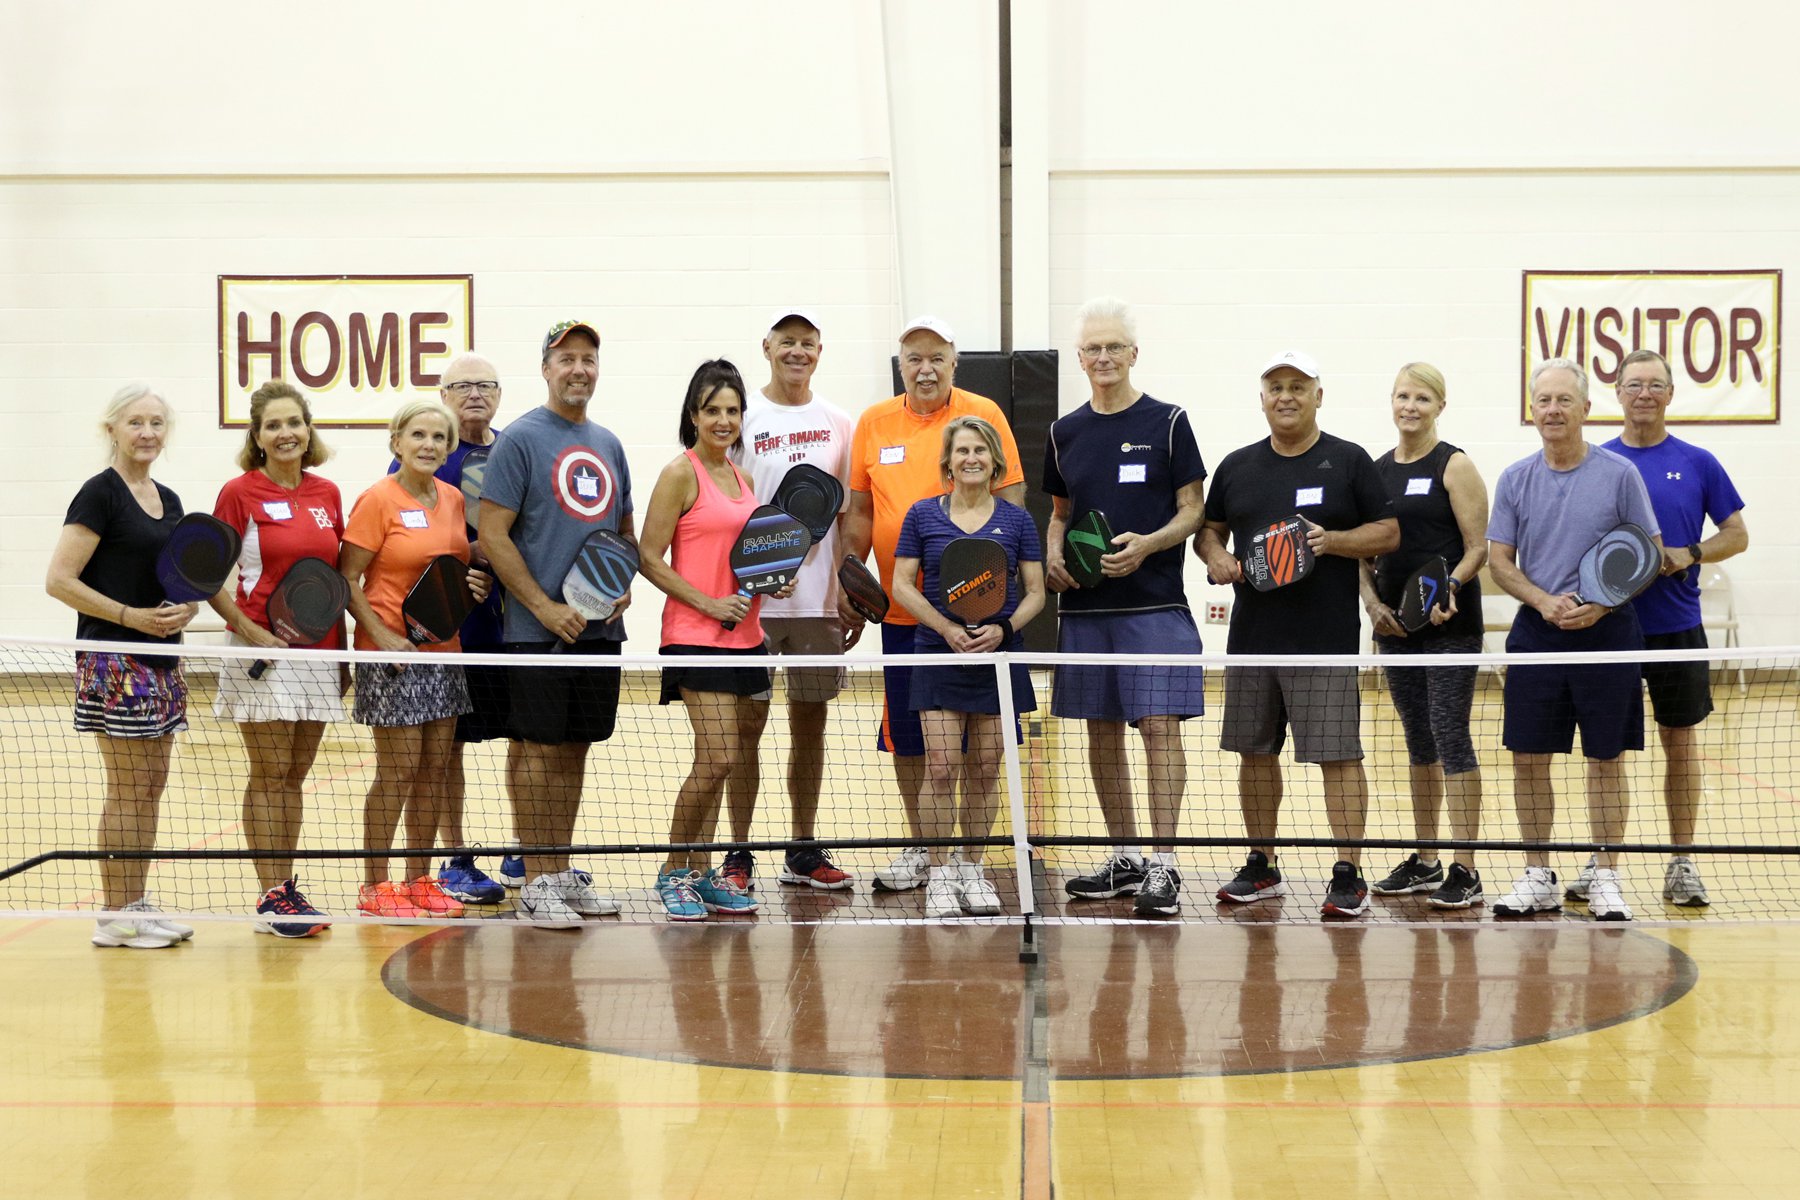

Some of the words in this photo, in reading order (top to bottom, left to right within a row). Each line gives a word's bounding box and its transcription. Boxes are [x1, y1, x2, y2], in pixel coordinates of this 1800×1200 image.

[237, 311, 450, 388] HOME
[1535, 306, 1765, 384] VISITOR
[754, 431, 770, 442] HIGH
[763, 443, 827, 457] PICKLEBALL
[1265, 521, 1299, 538] SELKIRK
[743, 530, 794, 548] RALLY
[743, 537, 801, 555] GRAPHITE
[948, 570, 993, 604] ATOMIC
